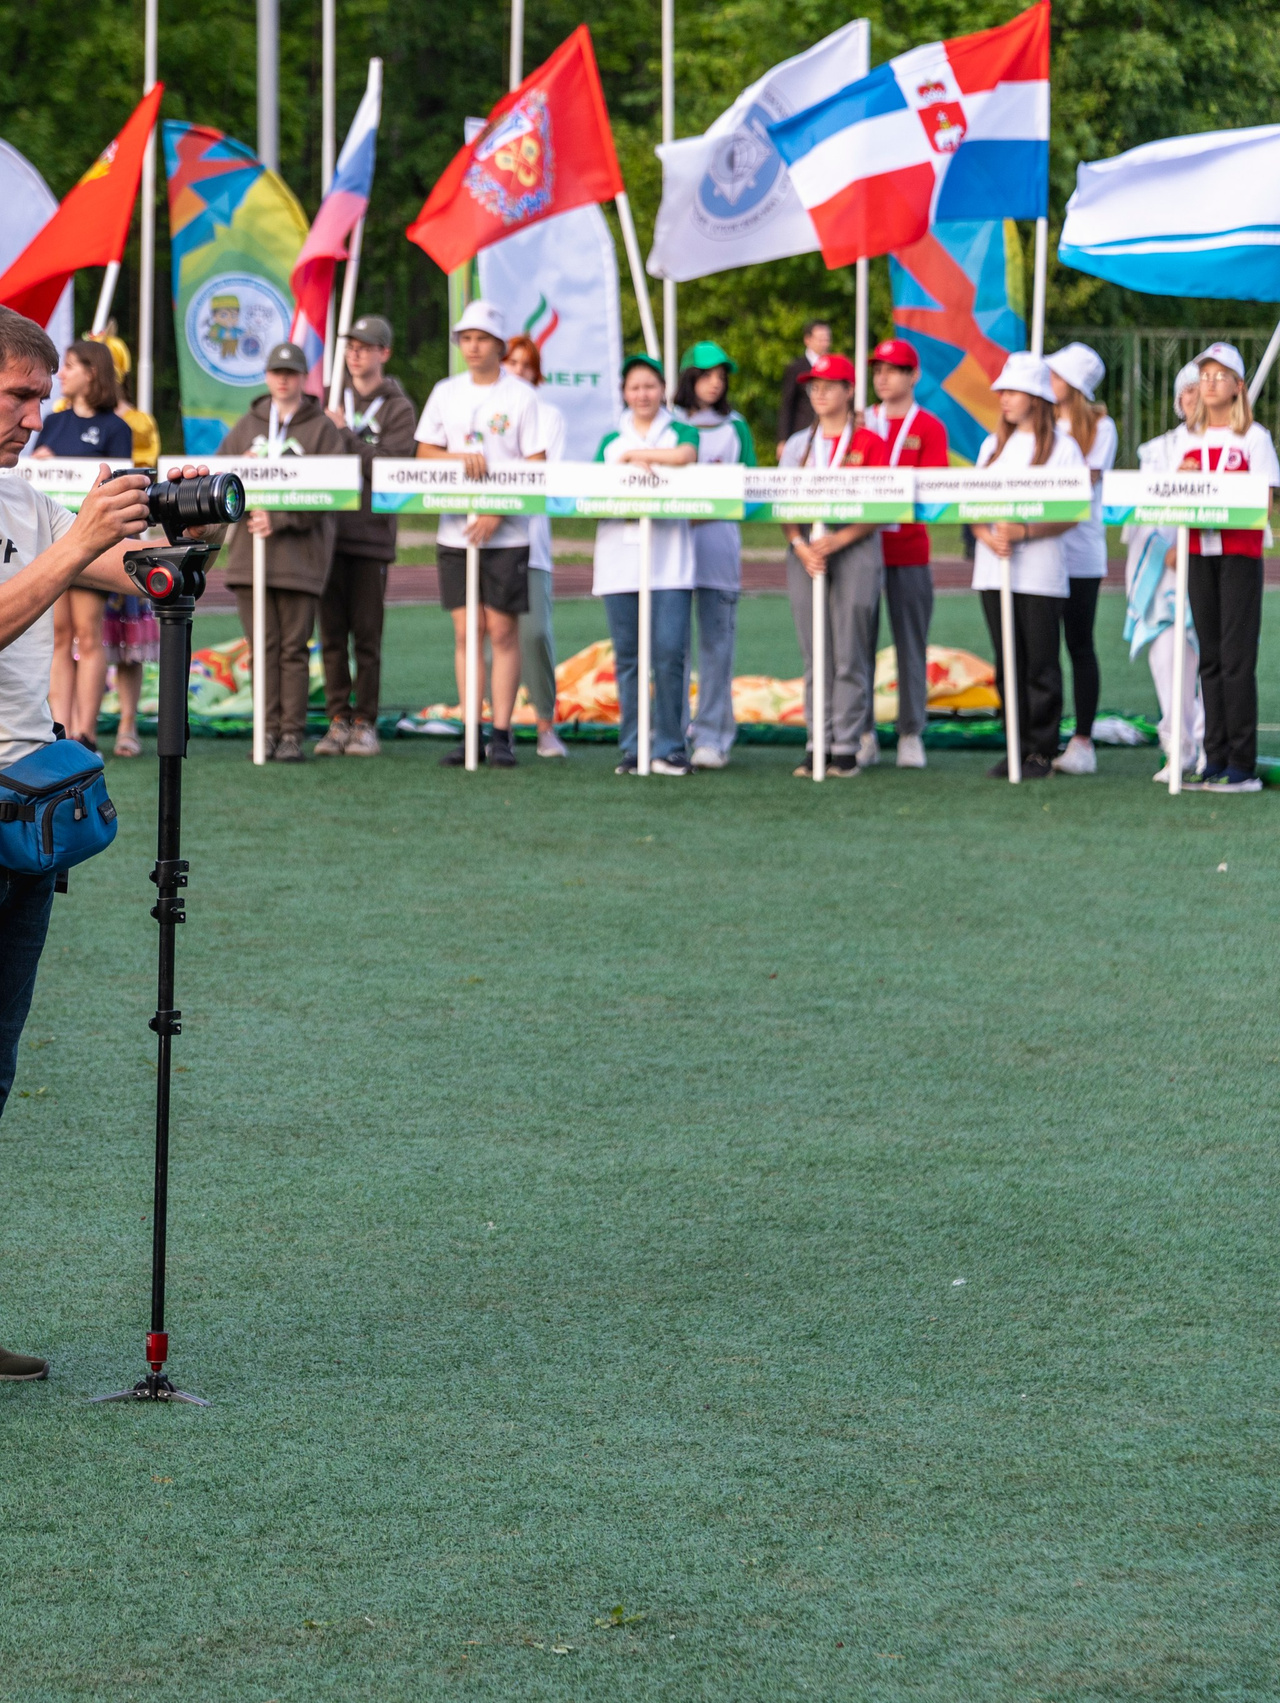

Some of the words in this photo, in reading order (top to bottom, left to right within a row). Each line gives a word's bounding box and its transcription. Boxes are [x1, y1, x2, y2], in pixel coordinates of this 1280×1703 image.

[388, 470, 457, 485] «ОМСКИЕ
[462, 471, 546, 486] МАМОНТЯТ
[622, 473, 669, 488] «РИФ»
[281, 489, 334, 506] область
[1148, 482, 1218, 498] «АДАМАНТ»
[422, 494, 470, 510] Омская
[471, 494, 525, 511] область
[663, 497, 716, 514] область
